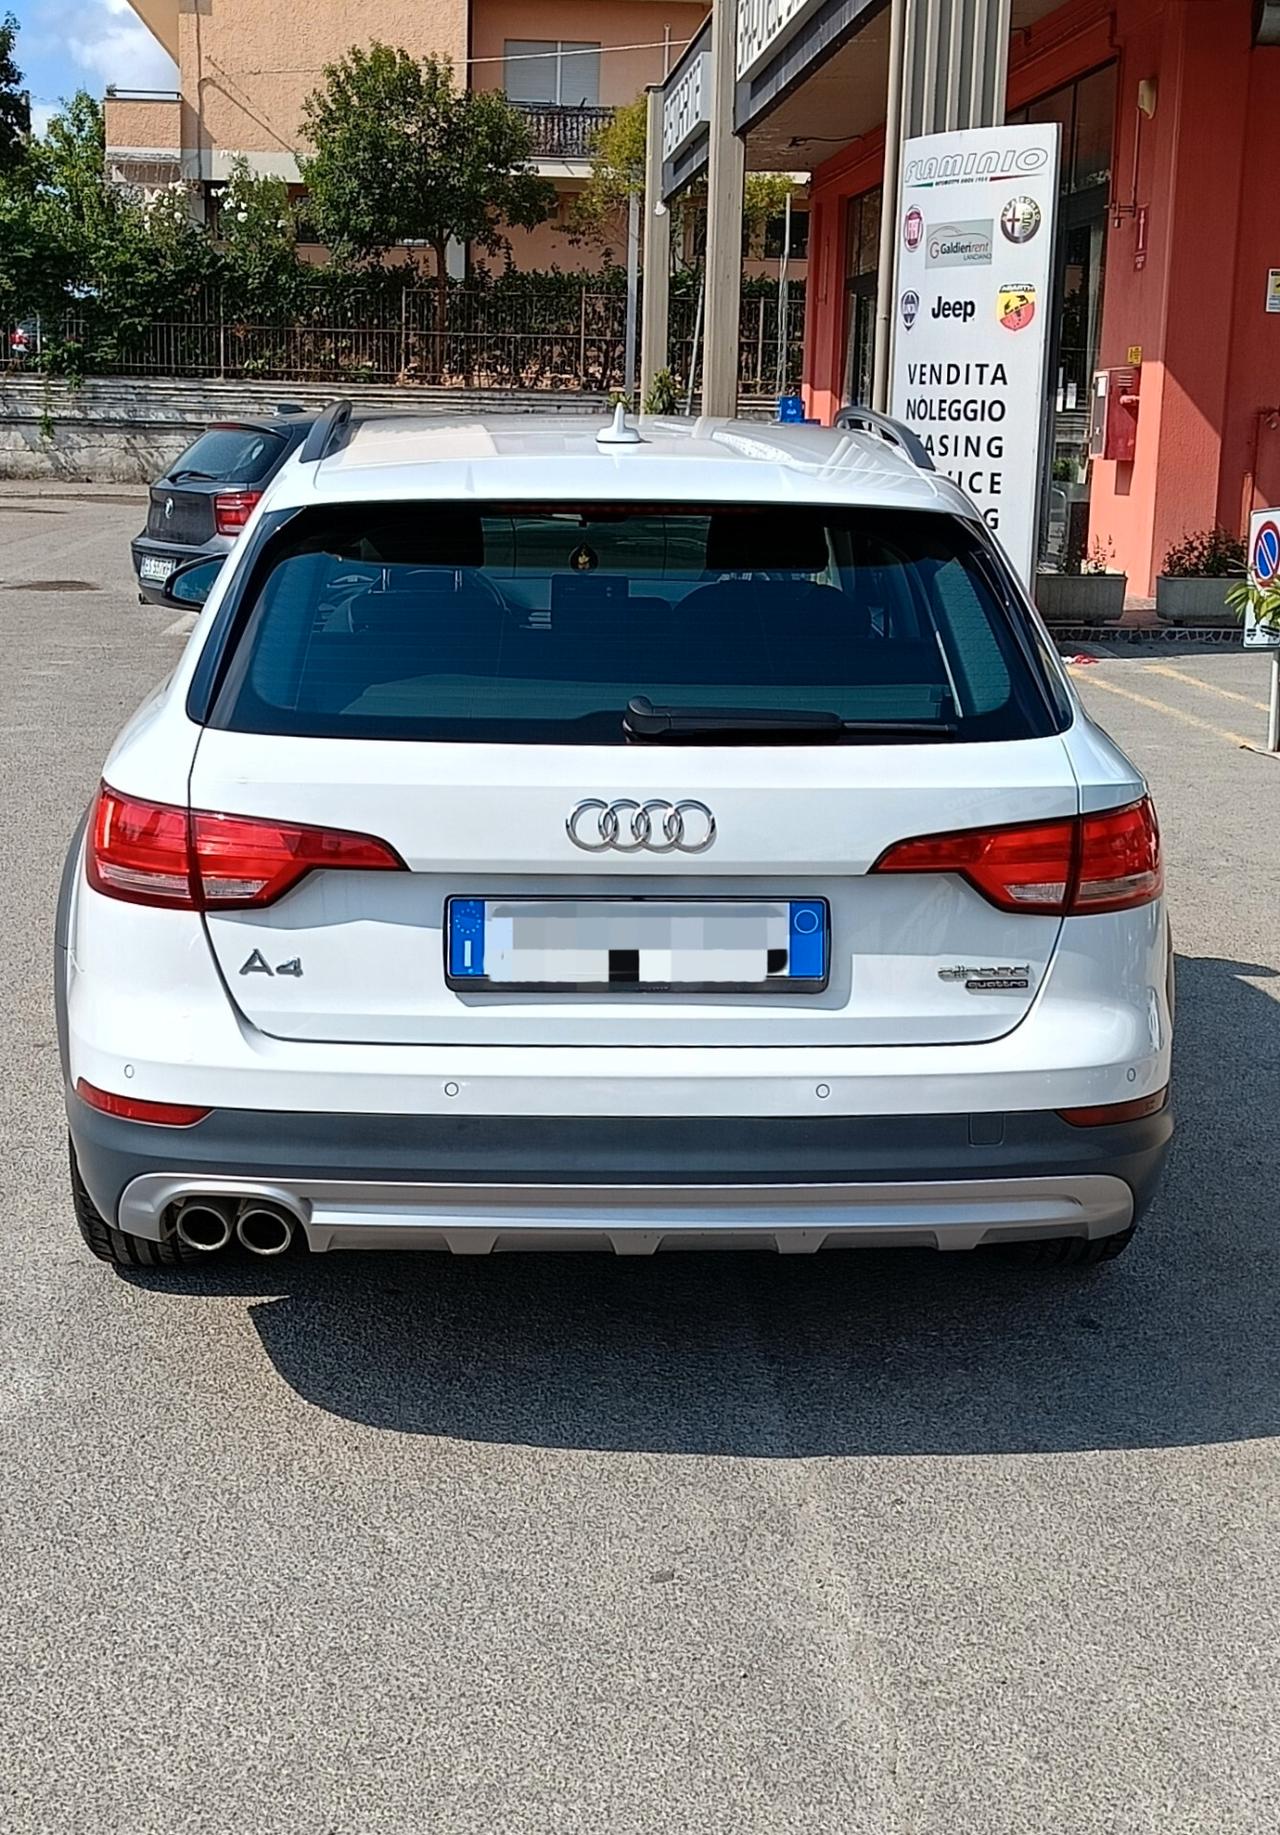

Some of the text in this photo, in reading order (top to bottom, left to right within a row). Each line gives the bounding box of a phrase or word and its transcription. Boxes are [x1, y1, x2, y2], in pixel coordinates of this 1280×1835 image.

[931, 296, 975, 323] Jeep
[907, 363, 1008, 385] VENDITA
[906, 398, 1006, 422] NOLEGGIO
[915, 434, 1004, 459] ASING
[238, 948, 304, 978] A4
[966, 979, 1028, 989] quattro
